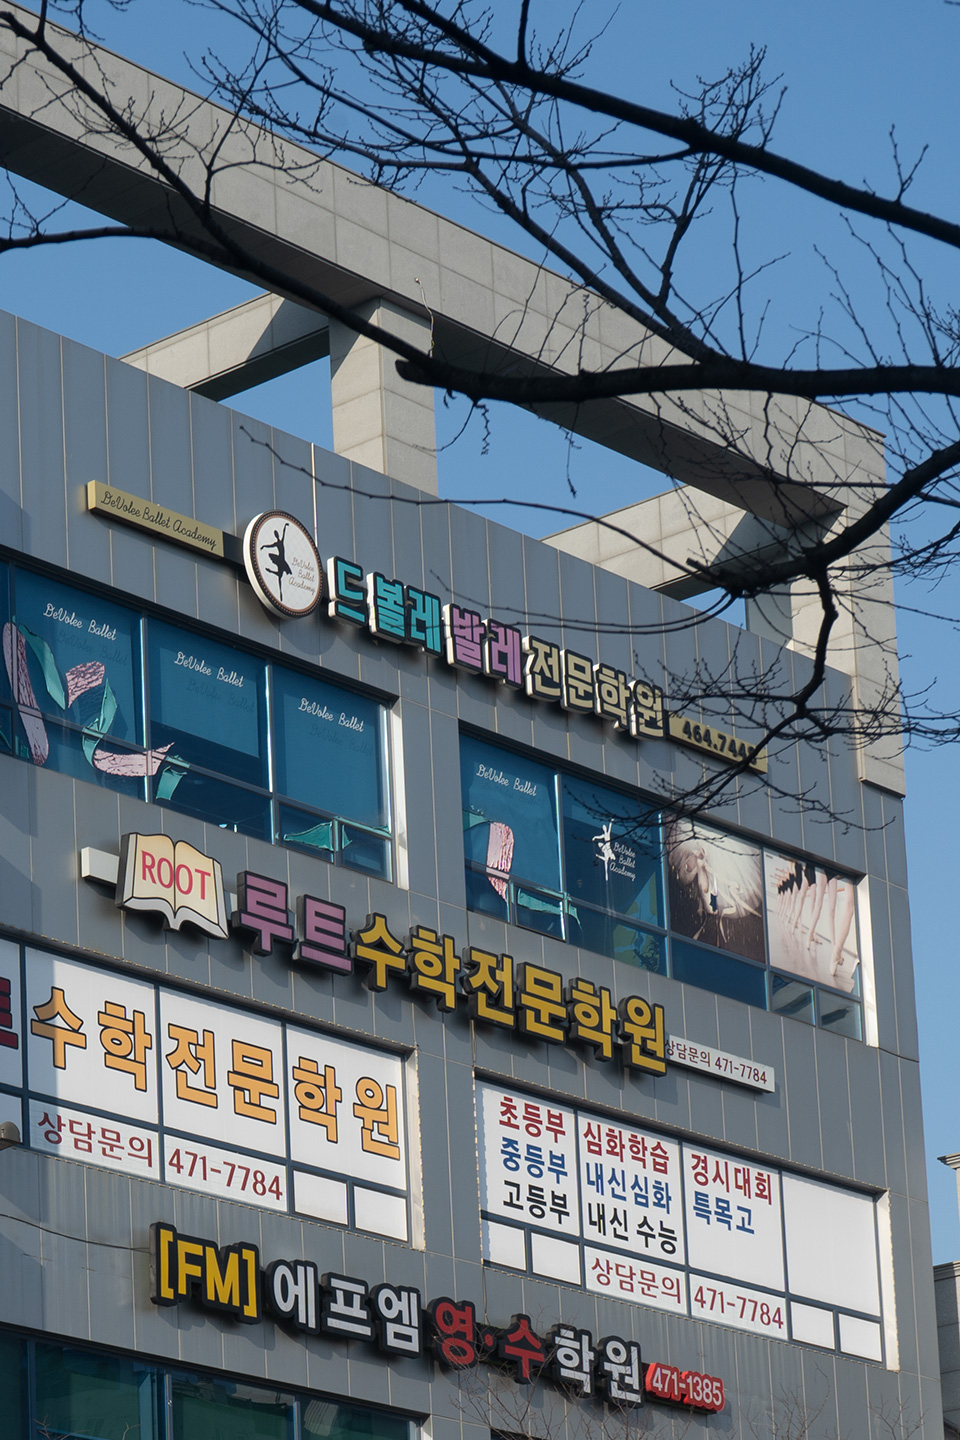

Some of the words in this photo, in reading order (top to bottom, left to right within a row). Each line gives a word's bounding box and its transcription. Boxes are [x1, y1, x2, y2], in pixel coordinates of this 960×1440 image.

[101, 491, 141, 519] DeVolee
[142, 505, 171, 530] Ballet
[172, 518, 217, 551] Academy
[43, 603, 83, 630] DeVolee
[88, 617, 117, 642] Ballet
[330, 557, 440, 654] 드볼레
[174, 651, 212, 677] DeVolee
[217, 664, 244, 689] Ballet
[297, 697, 334, 722] DeVolee
[338, 709, 364, 733] Ballet
[476, 763, 508, 787] DeVolee
[511, 775, 537, 797] Ballet
[140, 849, 211, 900] ROOT
[30, 986, 400, 1160] 수학전문학원
[664, 1039, 710, 1067] 상담문의
[715, 1050, 767, 1084] 471-7784
[36, 1111, 154, 1168] 상담문의
[168, 1149, 284, 1201] 471-7784
[499, 1096, 566, 1144] 초등부
[582, 1122, 670, 1175] 심화학습
[690, 1154, 773, 1205] 경시대회
[500, 1136, 568, 1185] 중등부
[585, 1162, 672, 1214] 내신심화
[692, 1191, 754, 1235] 특목고
[502, 1178, 570, 1225] 고등부
[588, 1202, 629, 1241] 내신
[636, 1217, 678, 1256] 수능
[159, 1228, 257, 1318] [FM]
[272, 1262, 420, 1352] 에프엠
[652, 1367, 724, 1406] 471-1385
[590, 1257, 682, 1304] 상담문의
[694, 1285, 784, 1330] 471-7784
